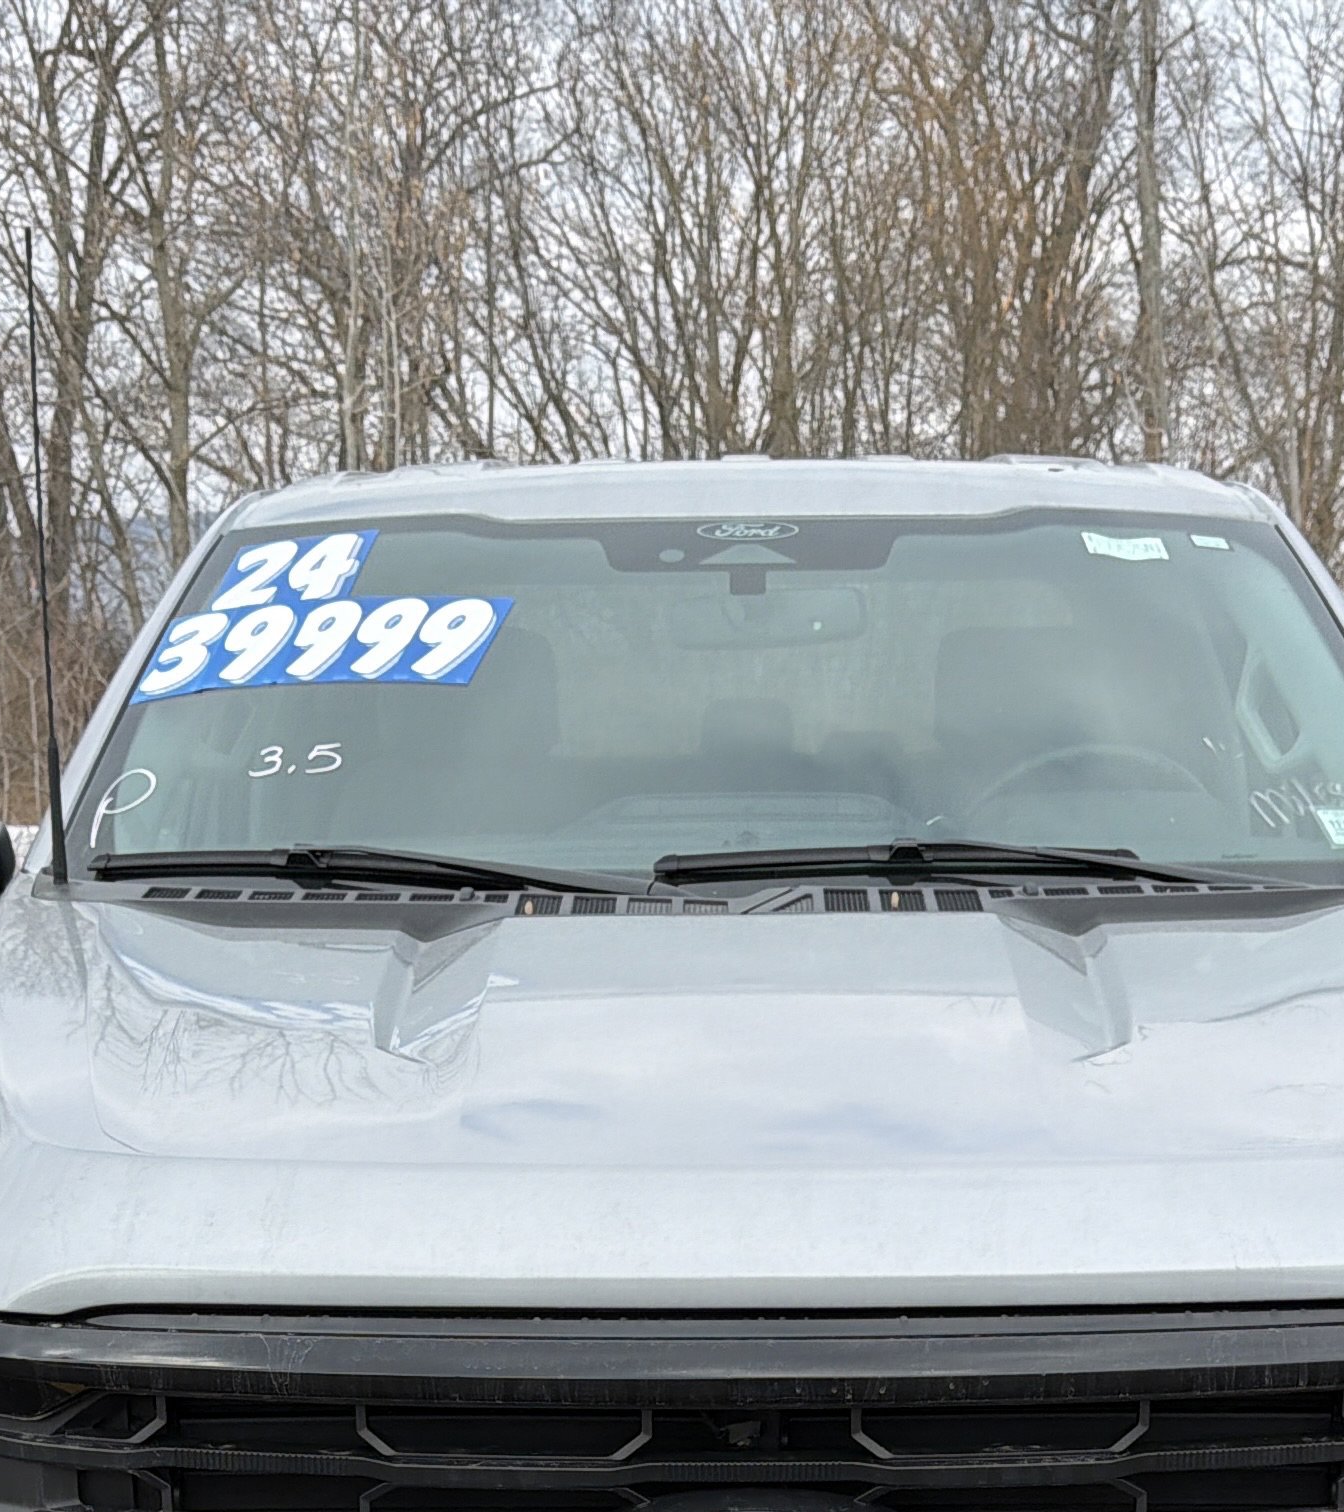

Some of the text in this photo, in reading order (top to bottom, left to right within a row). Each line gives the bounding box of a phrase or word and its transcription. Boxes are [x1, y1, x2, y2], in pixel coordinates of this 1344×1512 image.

[714, 523, 783, 537] Ford
[211, 533, 364, 611] 24
[139, 598, 498, 695] 39999
[248, 742, 343, 778] 3.5
